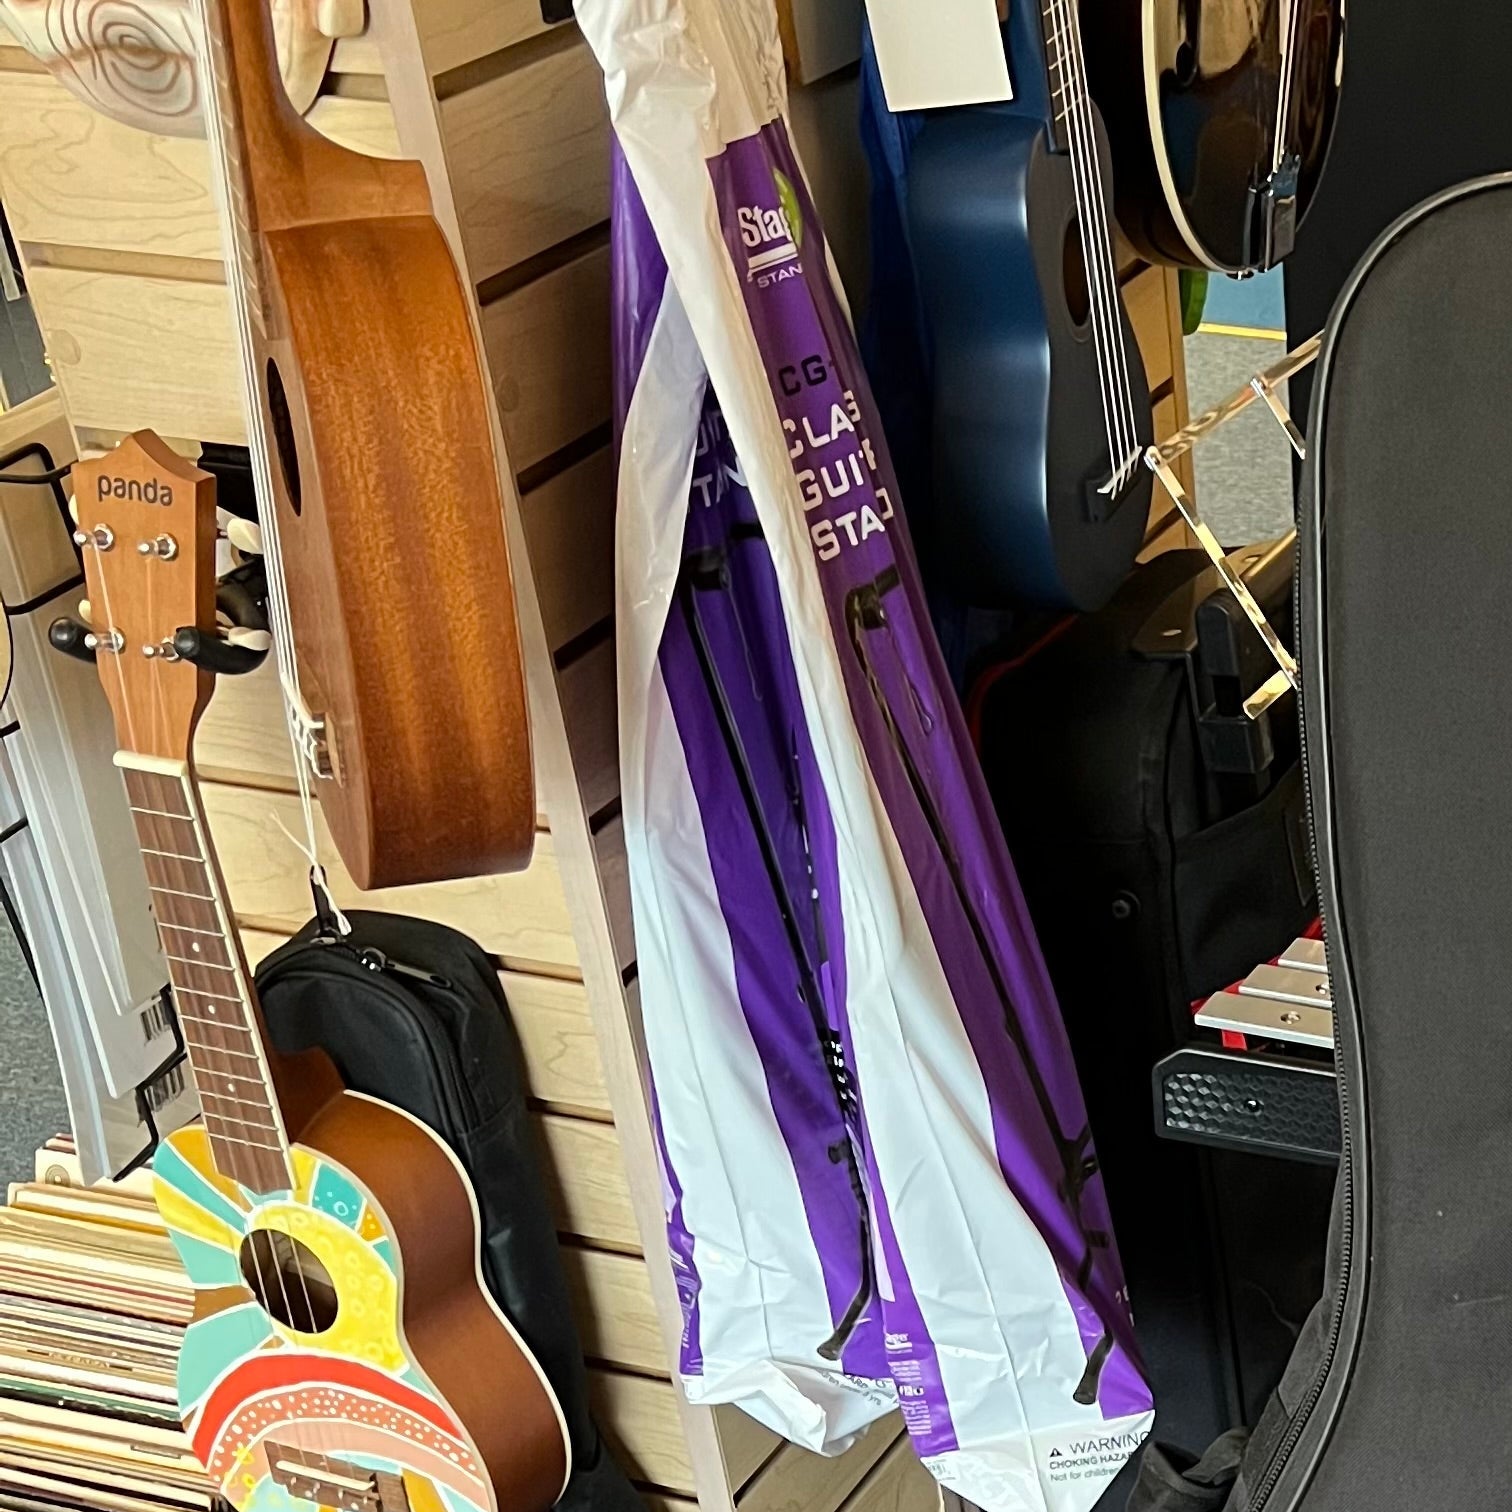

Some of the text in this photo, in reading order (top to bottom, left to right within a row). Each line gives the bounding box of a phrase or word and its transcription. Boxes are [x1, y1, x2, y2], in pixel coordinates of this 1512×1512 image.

[97, 475, 173, 507] panda
[1049, 1456, 1098, 1470] CHOKING
[1050, 1472, 1067, 1482] Not
